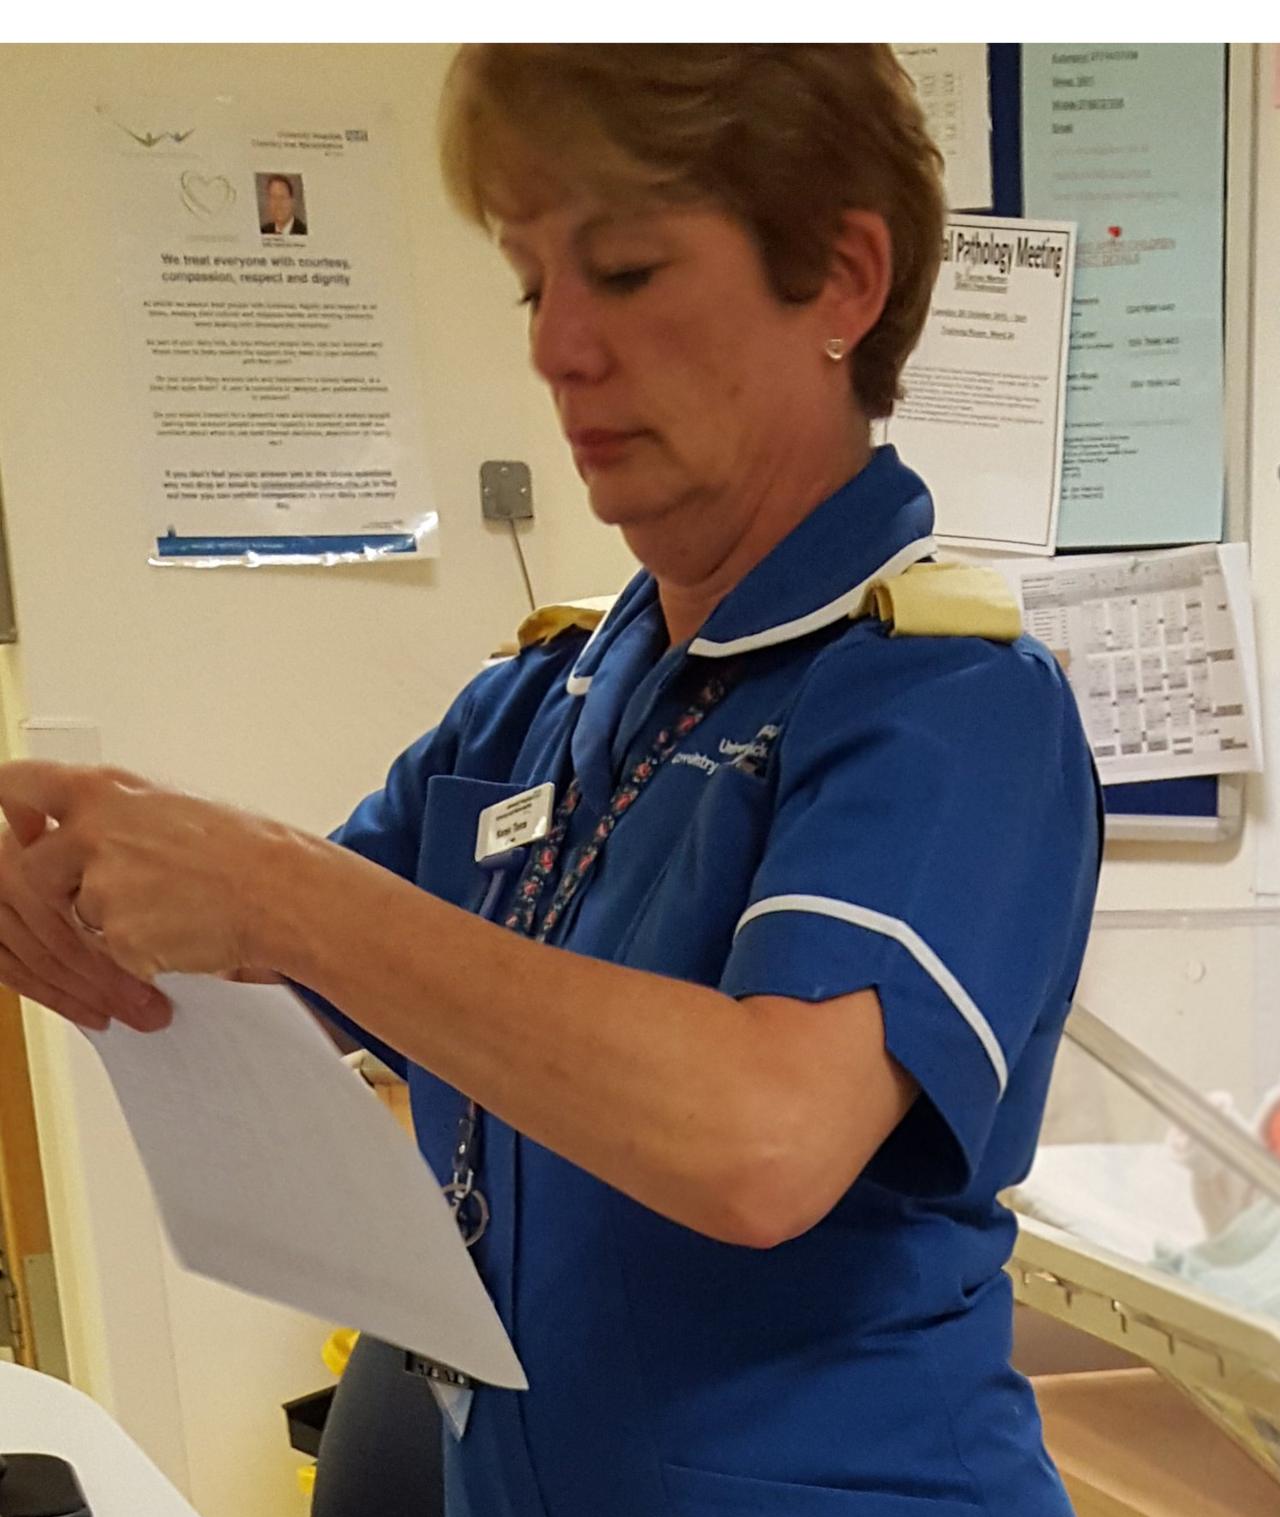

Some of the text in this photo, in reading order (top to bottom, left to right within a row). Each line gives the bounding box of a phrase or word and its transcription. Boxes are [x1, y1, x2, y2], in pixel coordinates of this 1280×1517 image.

[957, 232, 1016, 275] Pathology
[1016, 237, 1062, 279] Meeting
[214, 257, 267, 267] everyone
[271, 257, 294, 265] with
[240, 273, 282, 284] respect
[287, 274, 307, 283] and
